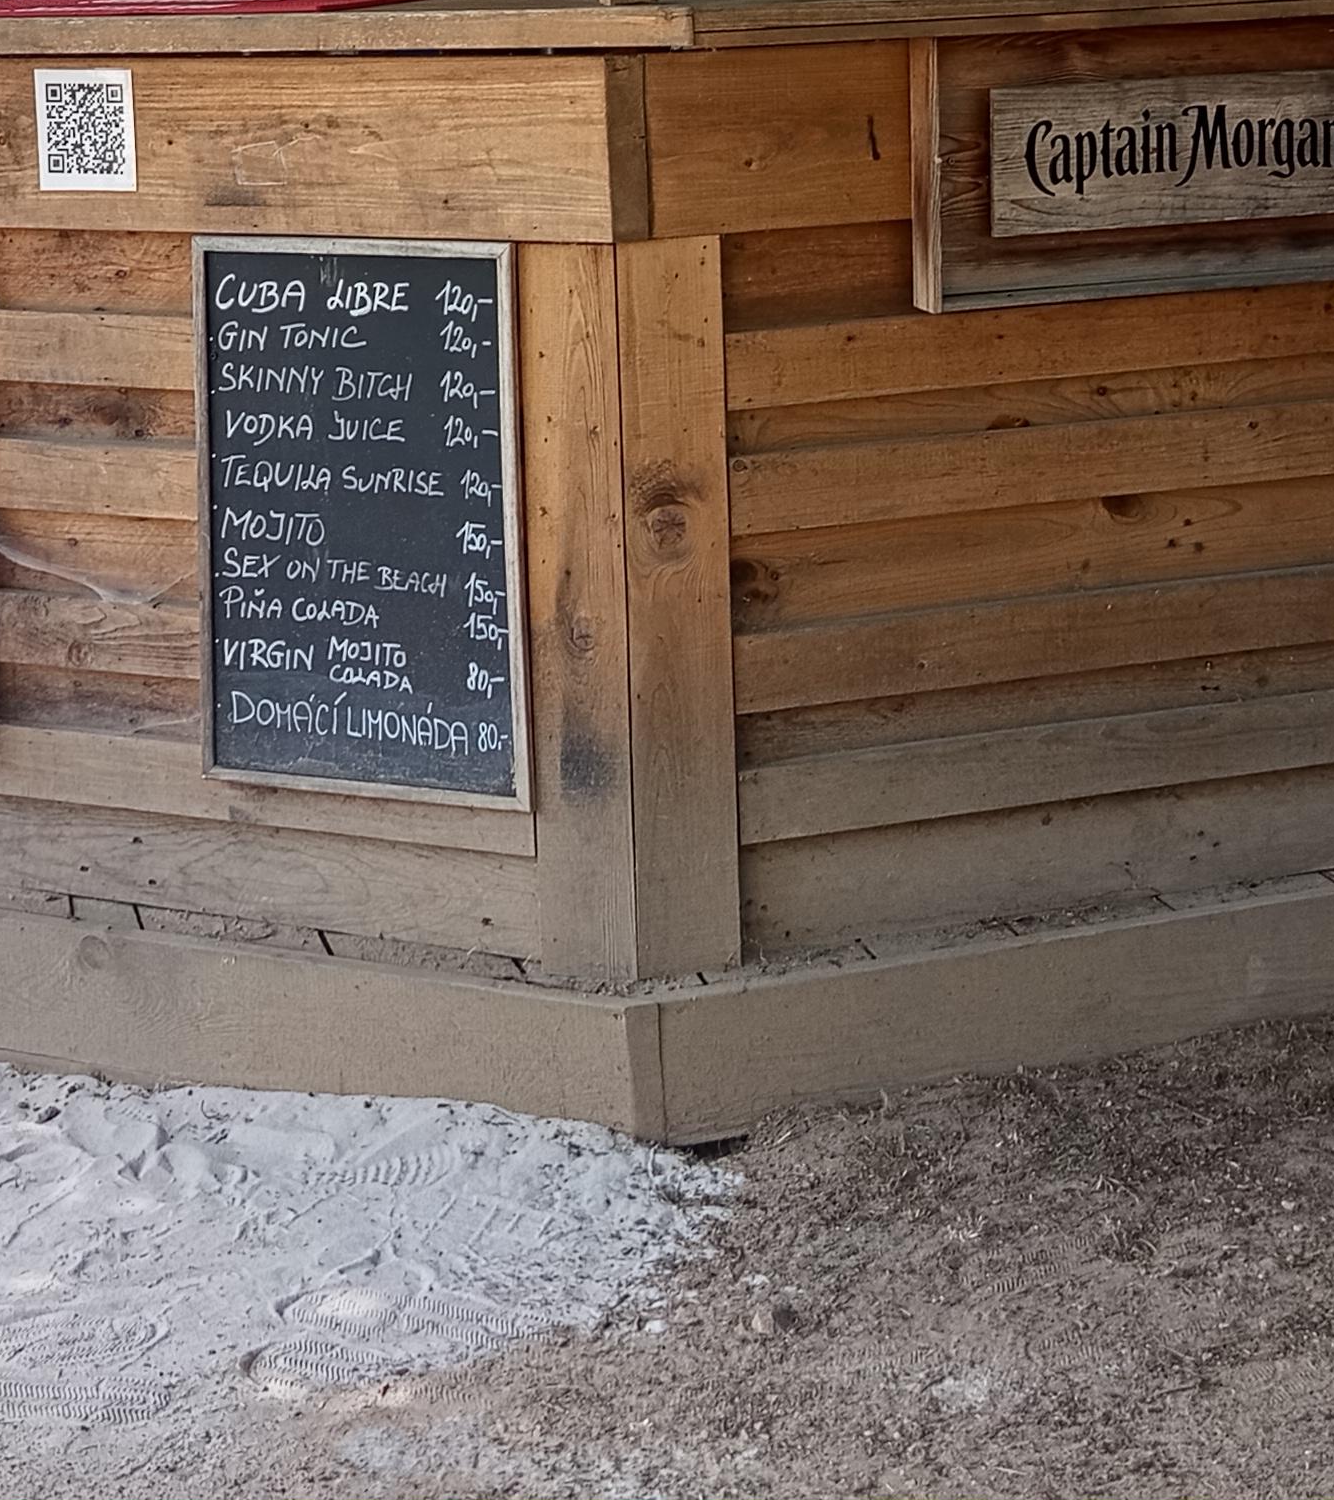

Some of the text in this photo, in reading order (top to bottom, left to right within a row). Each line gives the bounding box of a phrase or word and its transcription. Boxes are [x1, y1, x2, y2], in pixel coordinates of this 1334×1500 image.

[1024, 109, 1178, 197] Captain
[215, 273, 493, 322] CUBA LIBRE 120,-
[218, 320, 492, 358] GIN TONIC 120,-
[218, 362, 496, 409] SKINNY BITCH 120,-
[225, 409, 498, 448] VODKA JUICE 120,-
[221, 454, 503, 507] TEQUILA SUNRISE 120,-
[221, 507, 503, 558] MOJITO 150,-
[222, 547, 506, 615] SEX ON THE BEACH 150,-
[291, 597, 380, 629] COLADA
[463, 611, 510, 650] 150,-
[223, 635, 407, 671] VIRGIN MOJITO
[329, 664, 414, 694] COLADA
[231, 690, 348, 737] DOMÁCÍ
[346, 702, 469, 755] LIMONÁDA
